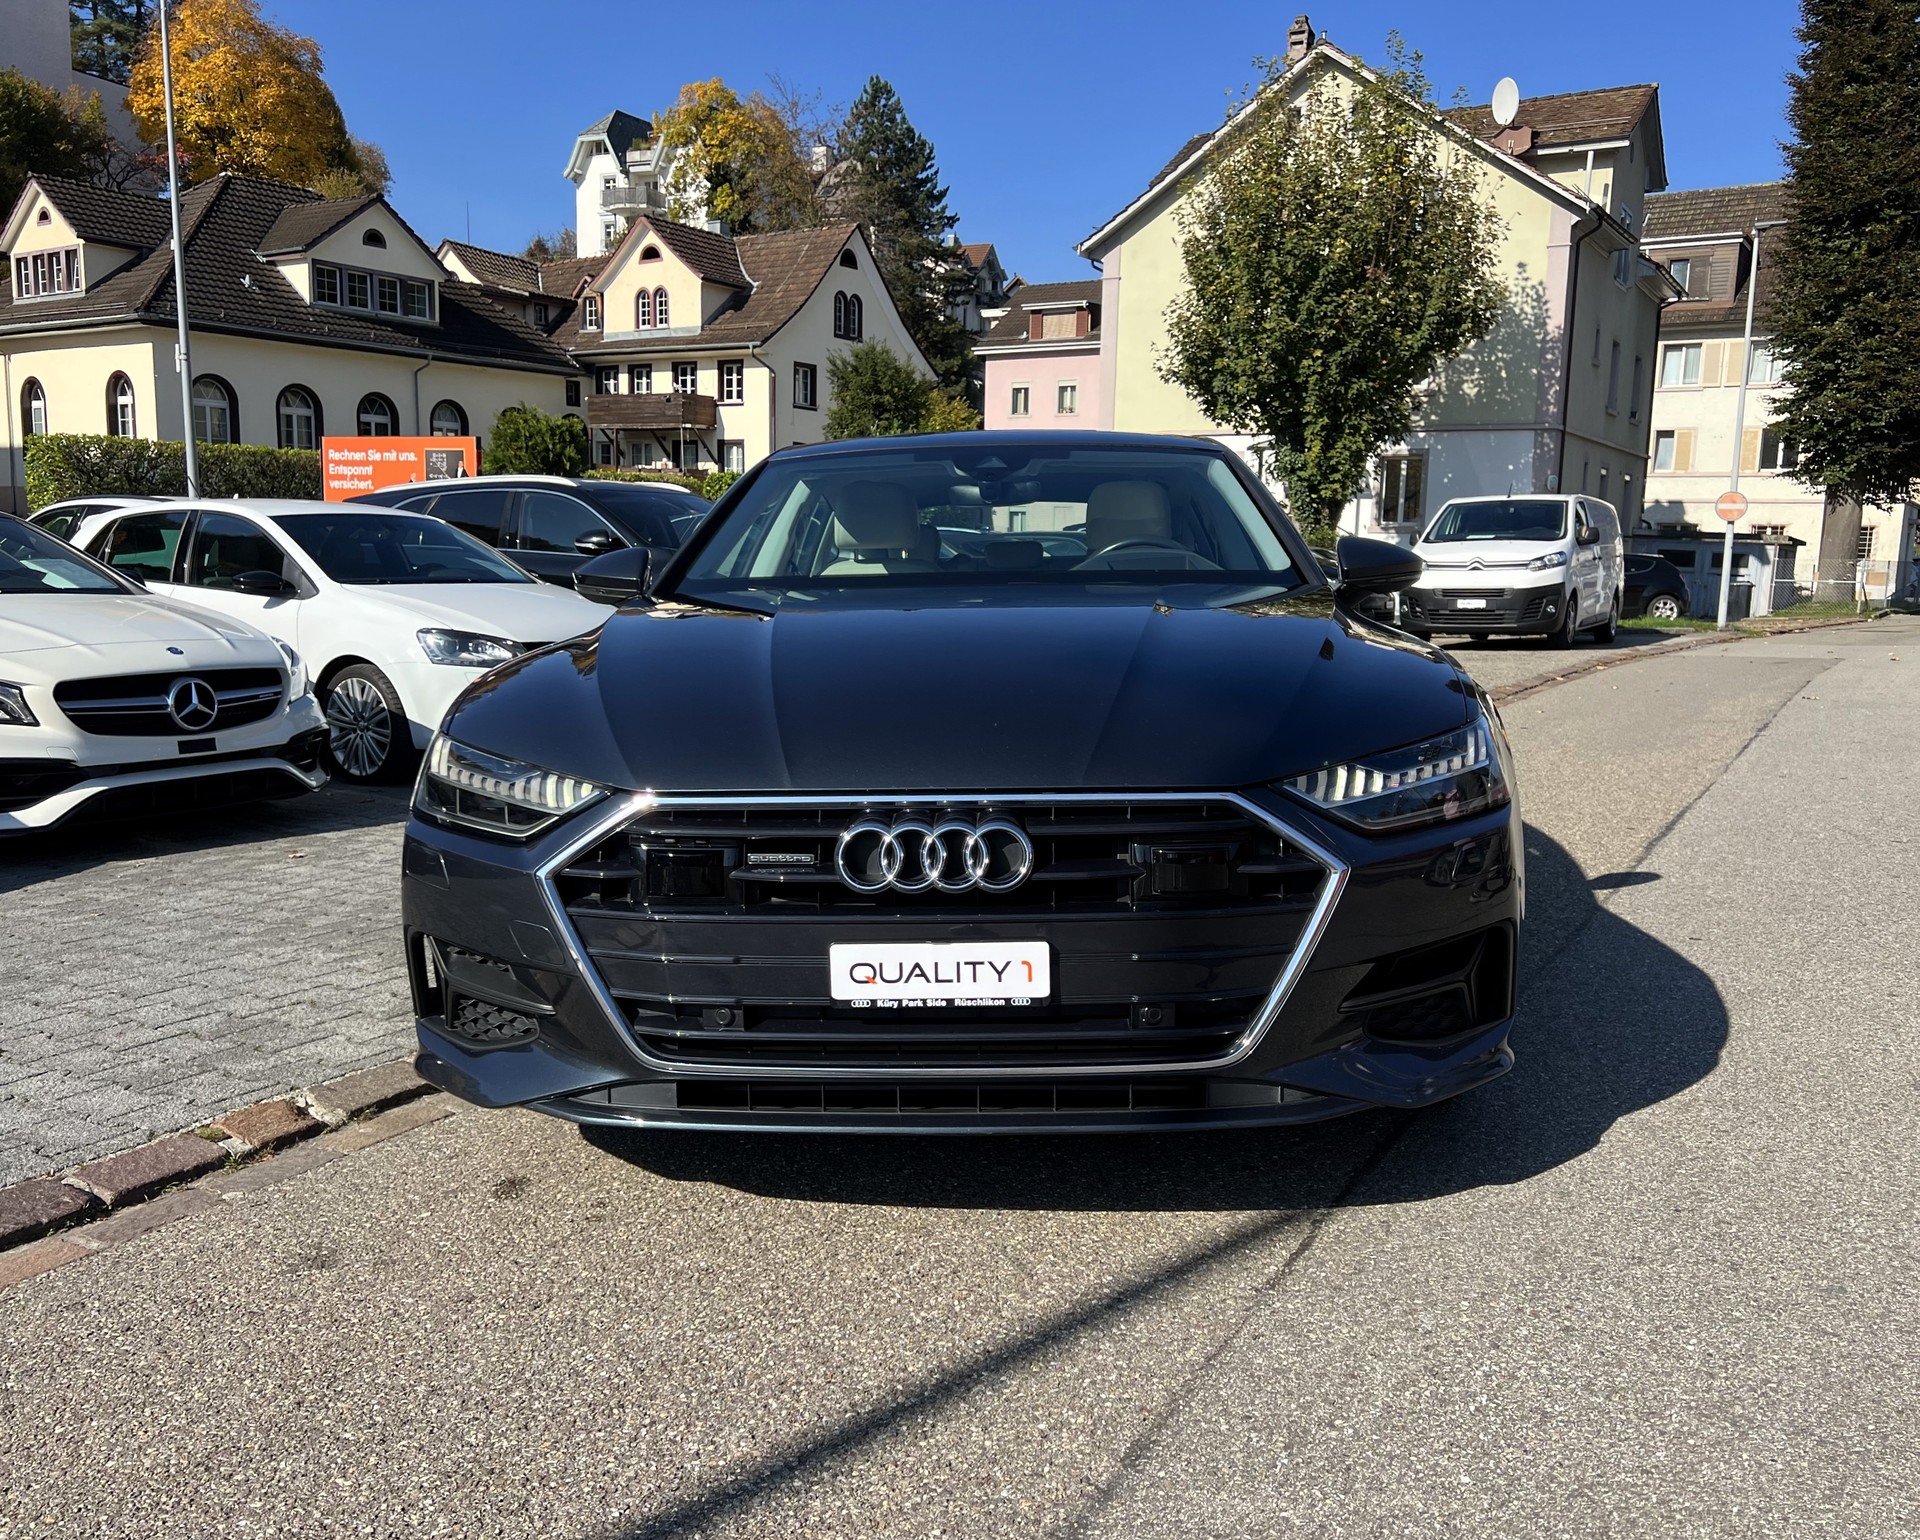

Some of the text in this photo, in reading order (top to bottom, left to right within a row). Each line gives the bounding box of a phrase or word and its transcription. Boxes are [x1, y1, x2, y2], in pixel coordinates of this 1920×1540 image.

[328, 449, 418, 461] Rechnen Sie mit uns.
[328, 464, 373, 477] Entspannt
[328, 478, 374, 490] versichert.
[750, 855, 811, 863] quattro
[849, 960, 1033, 984] QUALITY 1
[876, 998, 1005, 1008] Küry Park Side Rüschlikon
